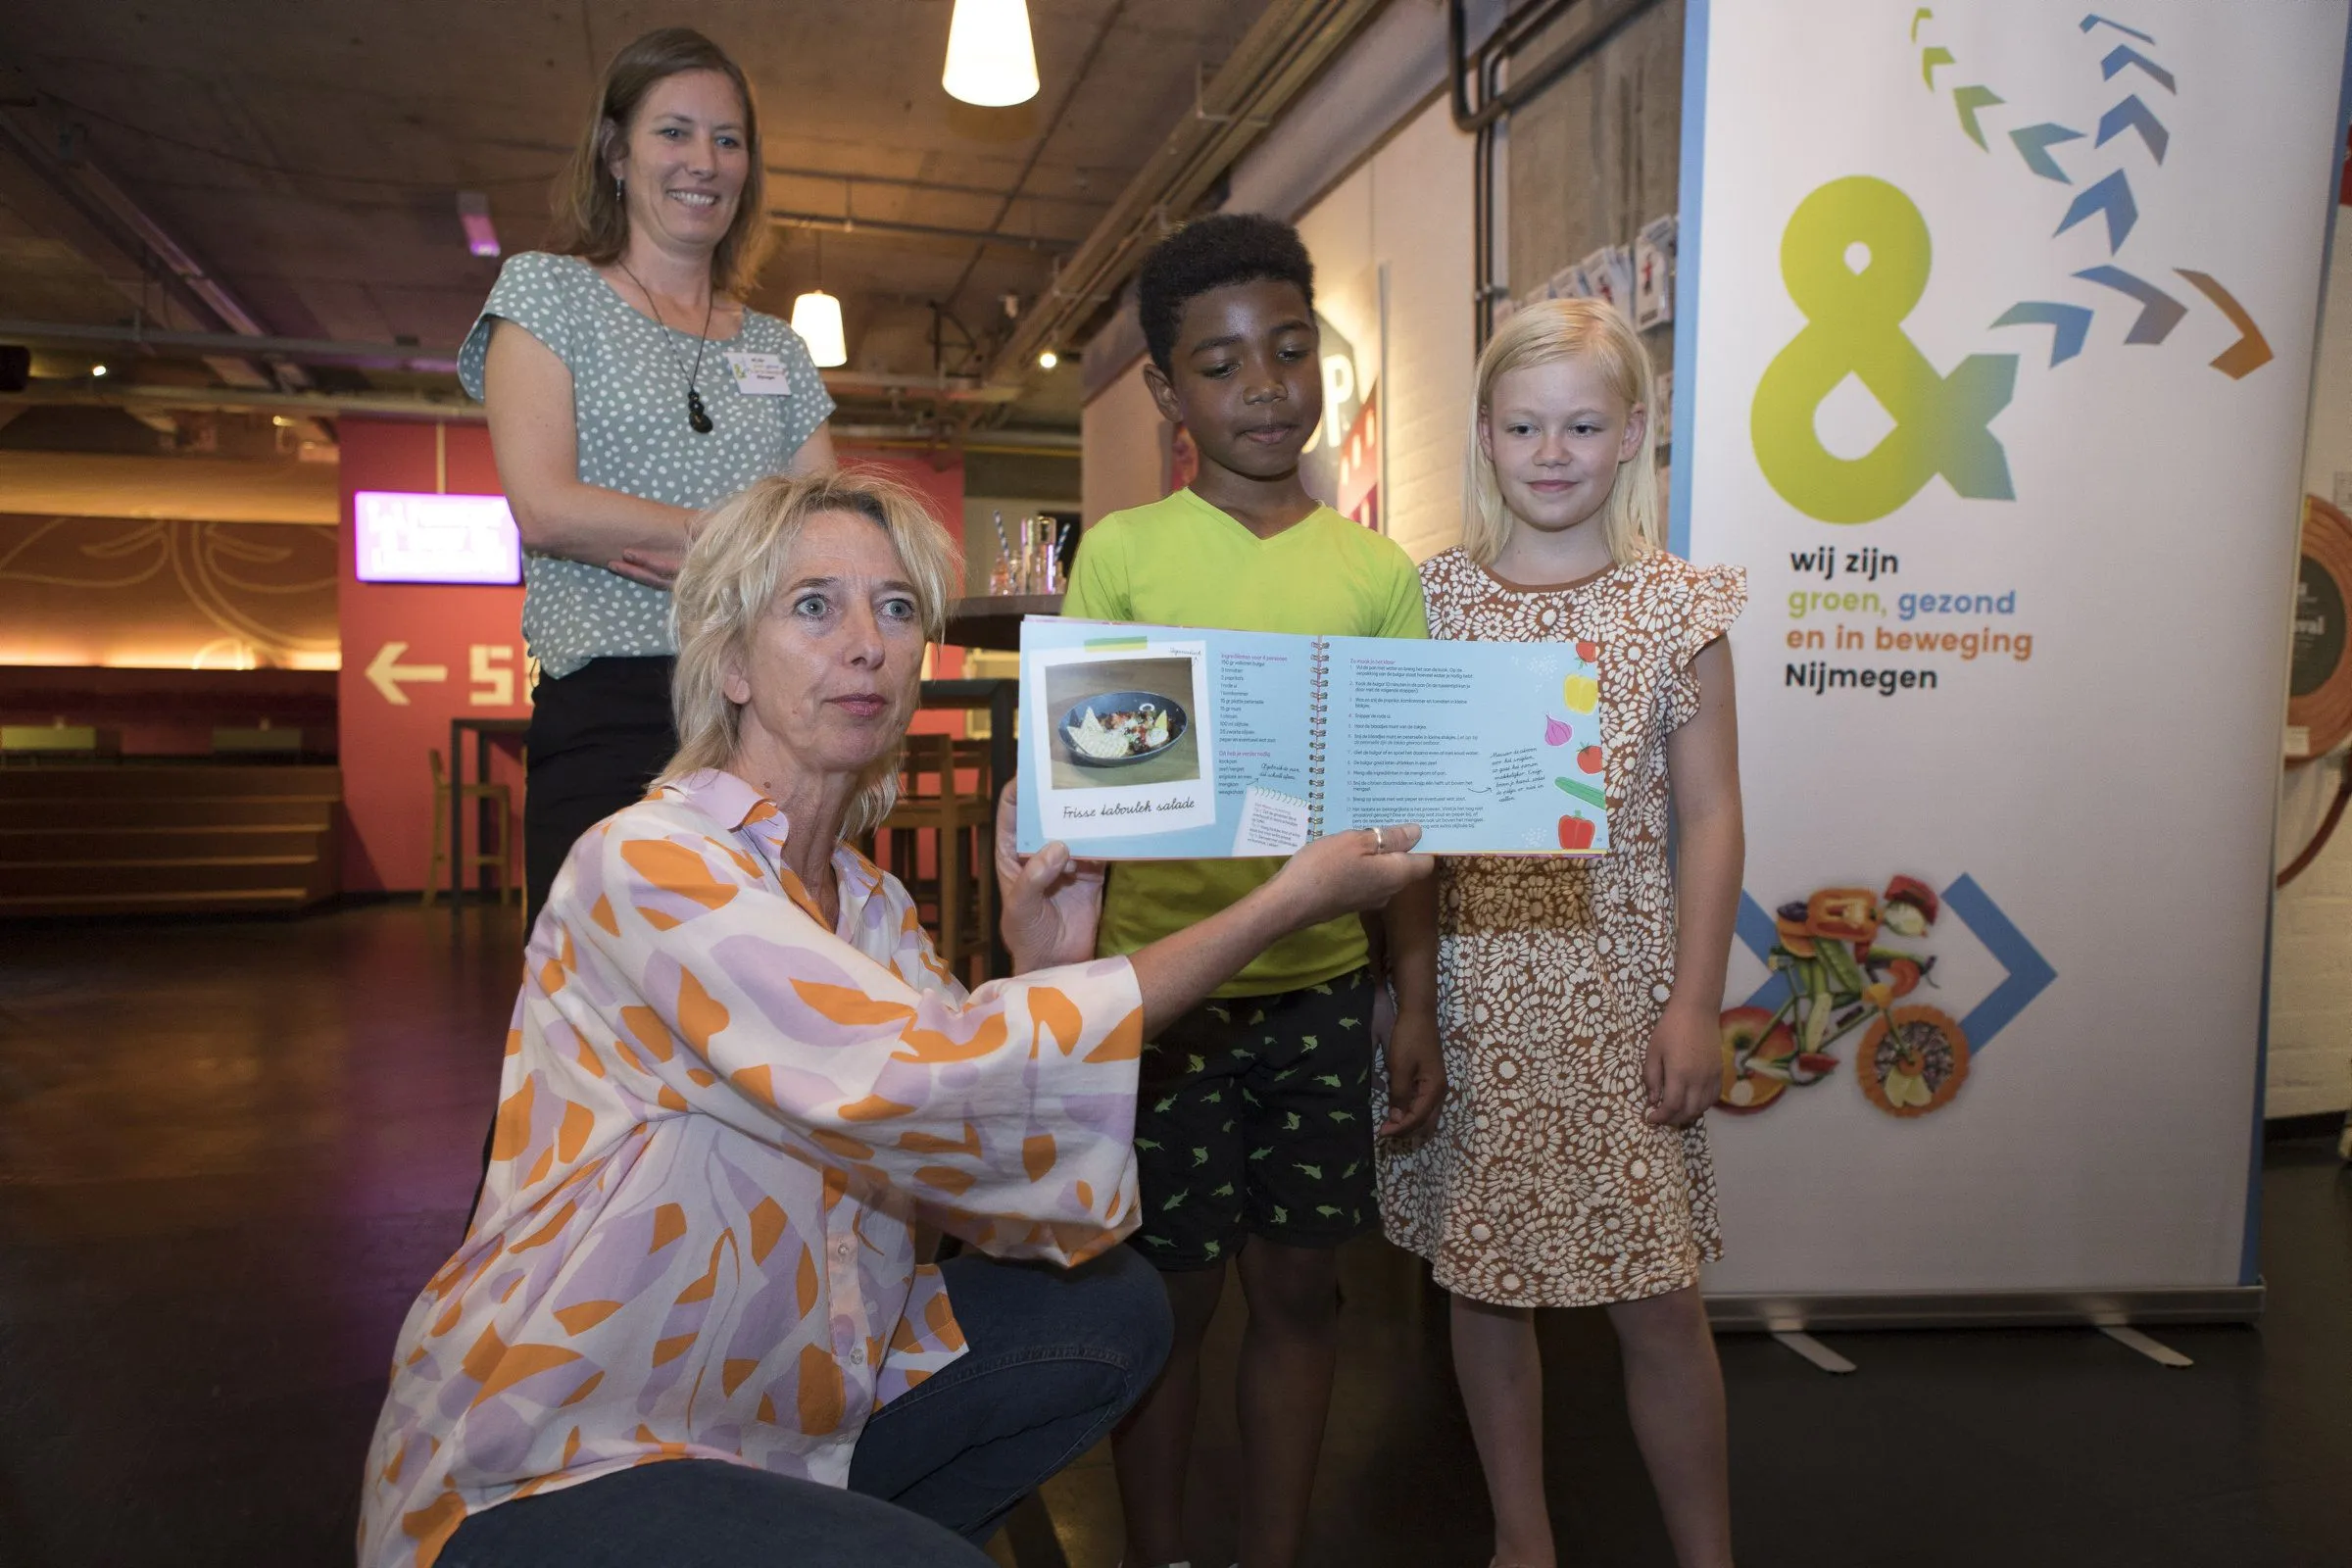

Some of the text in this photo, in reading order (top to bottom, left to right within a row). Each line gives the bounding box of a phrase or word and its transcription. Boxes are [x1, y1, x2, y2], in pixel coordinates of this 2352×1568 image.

[1790, 546, 1899, 581] wij zijn
[1788, 589, 2017, 621] groen, gezond
[1786, 624, 2034, 662] en in beweging
[1785, 662, 1938, 697] Nijmegen
[1061, 805, 1097, 819] Frisse
[1155, 795, 1195, 812] salade
